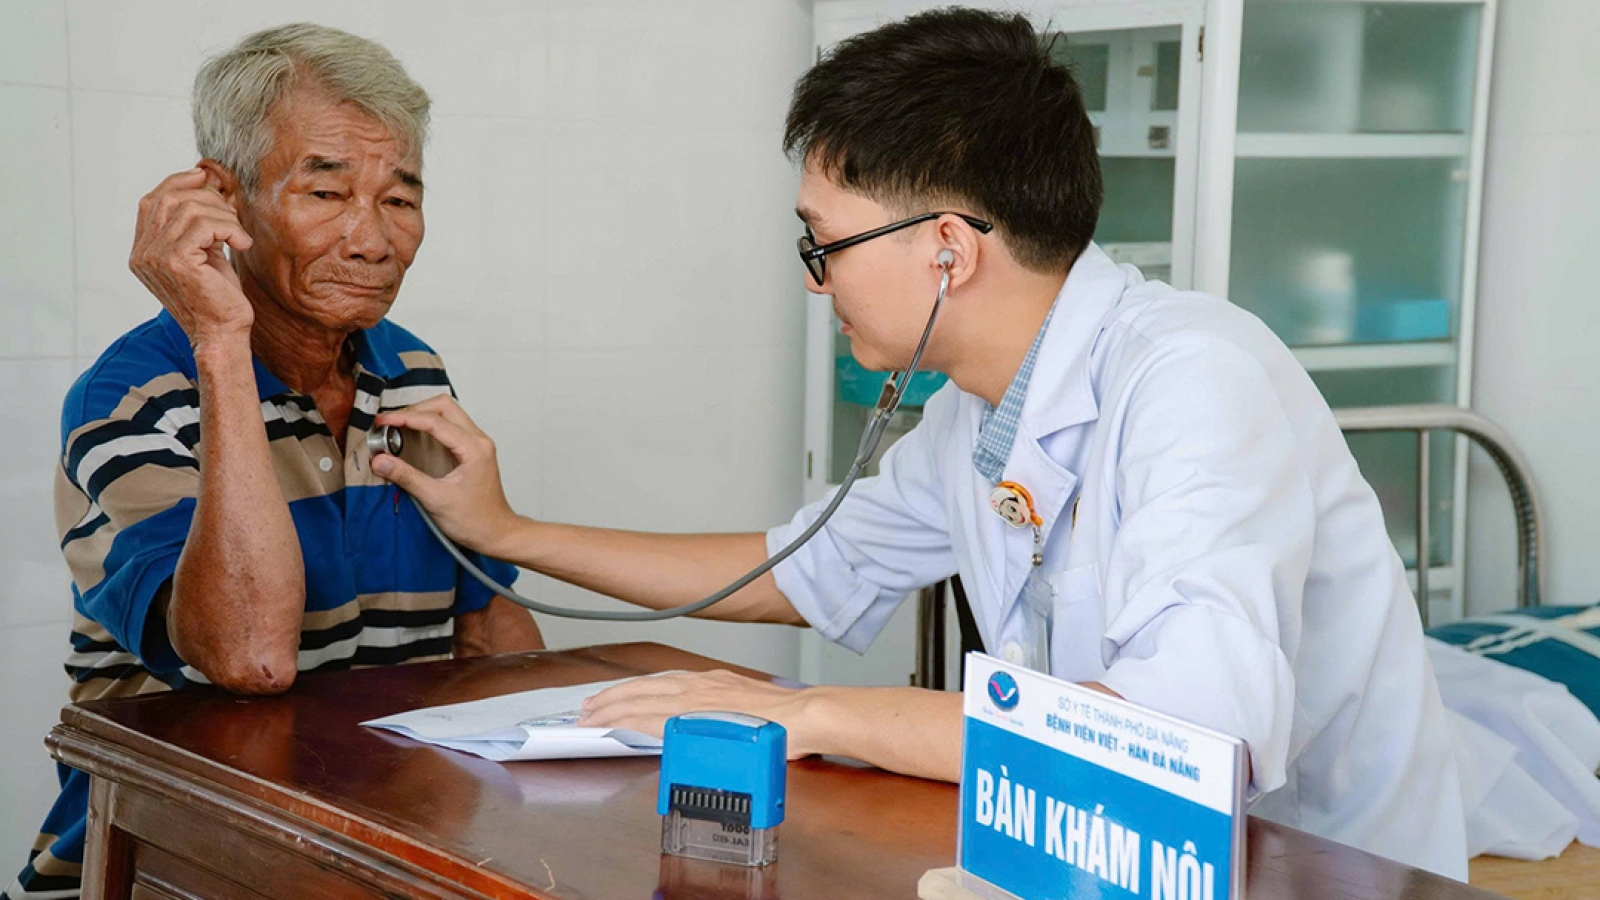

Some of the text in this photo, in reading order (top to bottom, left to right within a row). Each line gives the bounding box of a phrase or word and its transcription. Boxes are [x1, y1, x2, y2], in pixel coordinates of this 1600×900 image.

[1046, 713, 1071, 734] BỆNH
[1074, 723, 1095, 743] VIỆN
[1098, 731, 1118, 753] VIỆT
[1128, 743, 1149, 763] HÀN
[1152, 751, 1166, 769] ĐÀ
[1093, 708, 1123, 729] THÀNH
[976, 764, 1036, 847] BÀN
[1045, 795, 1141, 895] KHÁM
